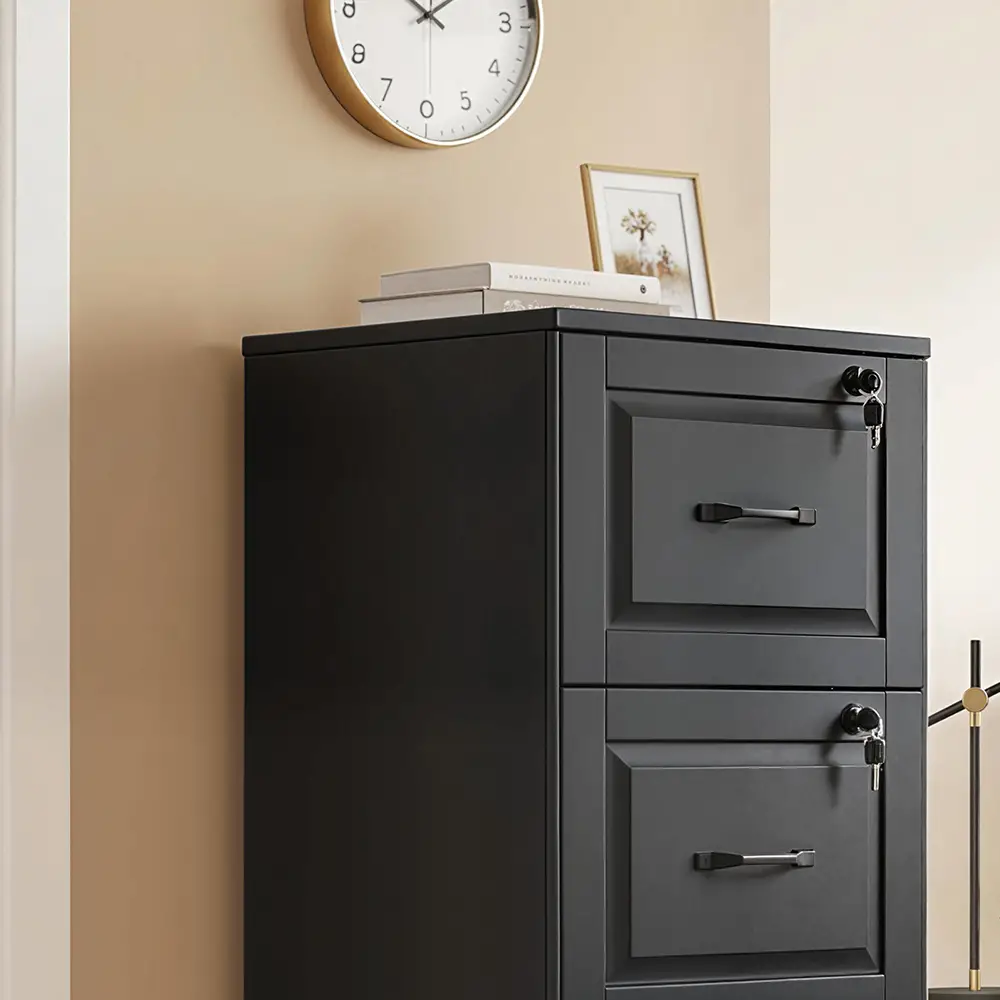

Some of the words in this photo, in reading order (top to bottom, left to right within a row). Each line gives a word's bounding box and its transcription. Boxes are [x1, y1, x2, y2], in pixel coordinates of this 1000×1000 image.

[499, 12, 512, 33] 3
[351, 43, 366, 64] 8
[488, 59, 501, 77] 4
[381, 78, 393, 101] 7
[420, 100, 434, 119] 0
[460, 91, 472, 111] 5
